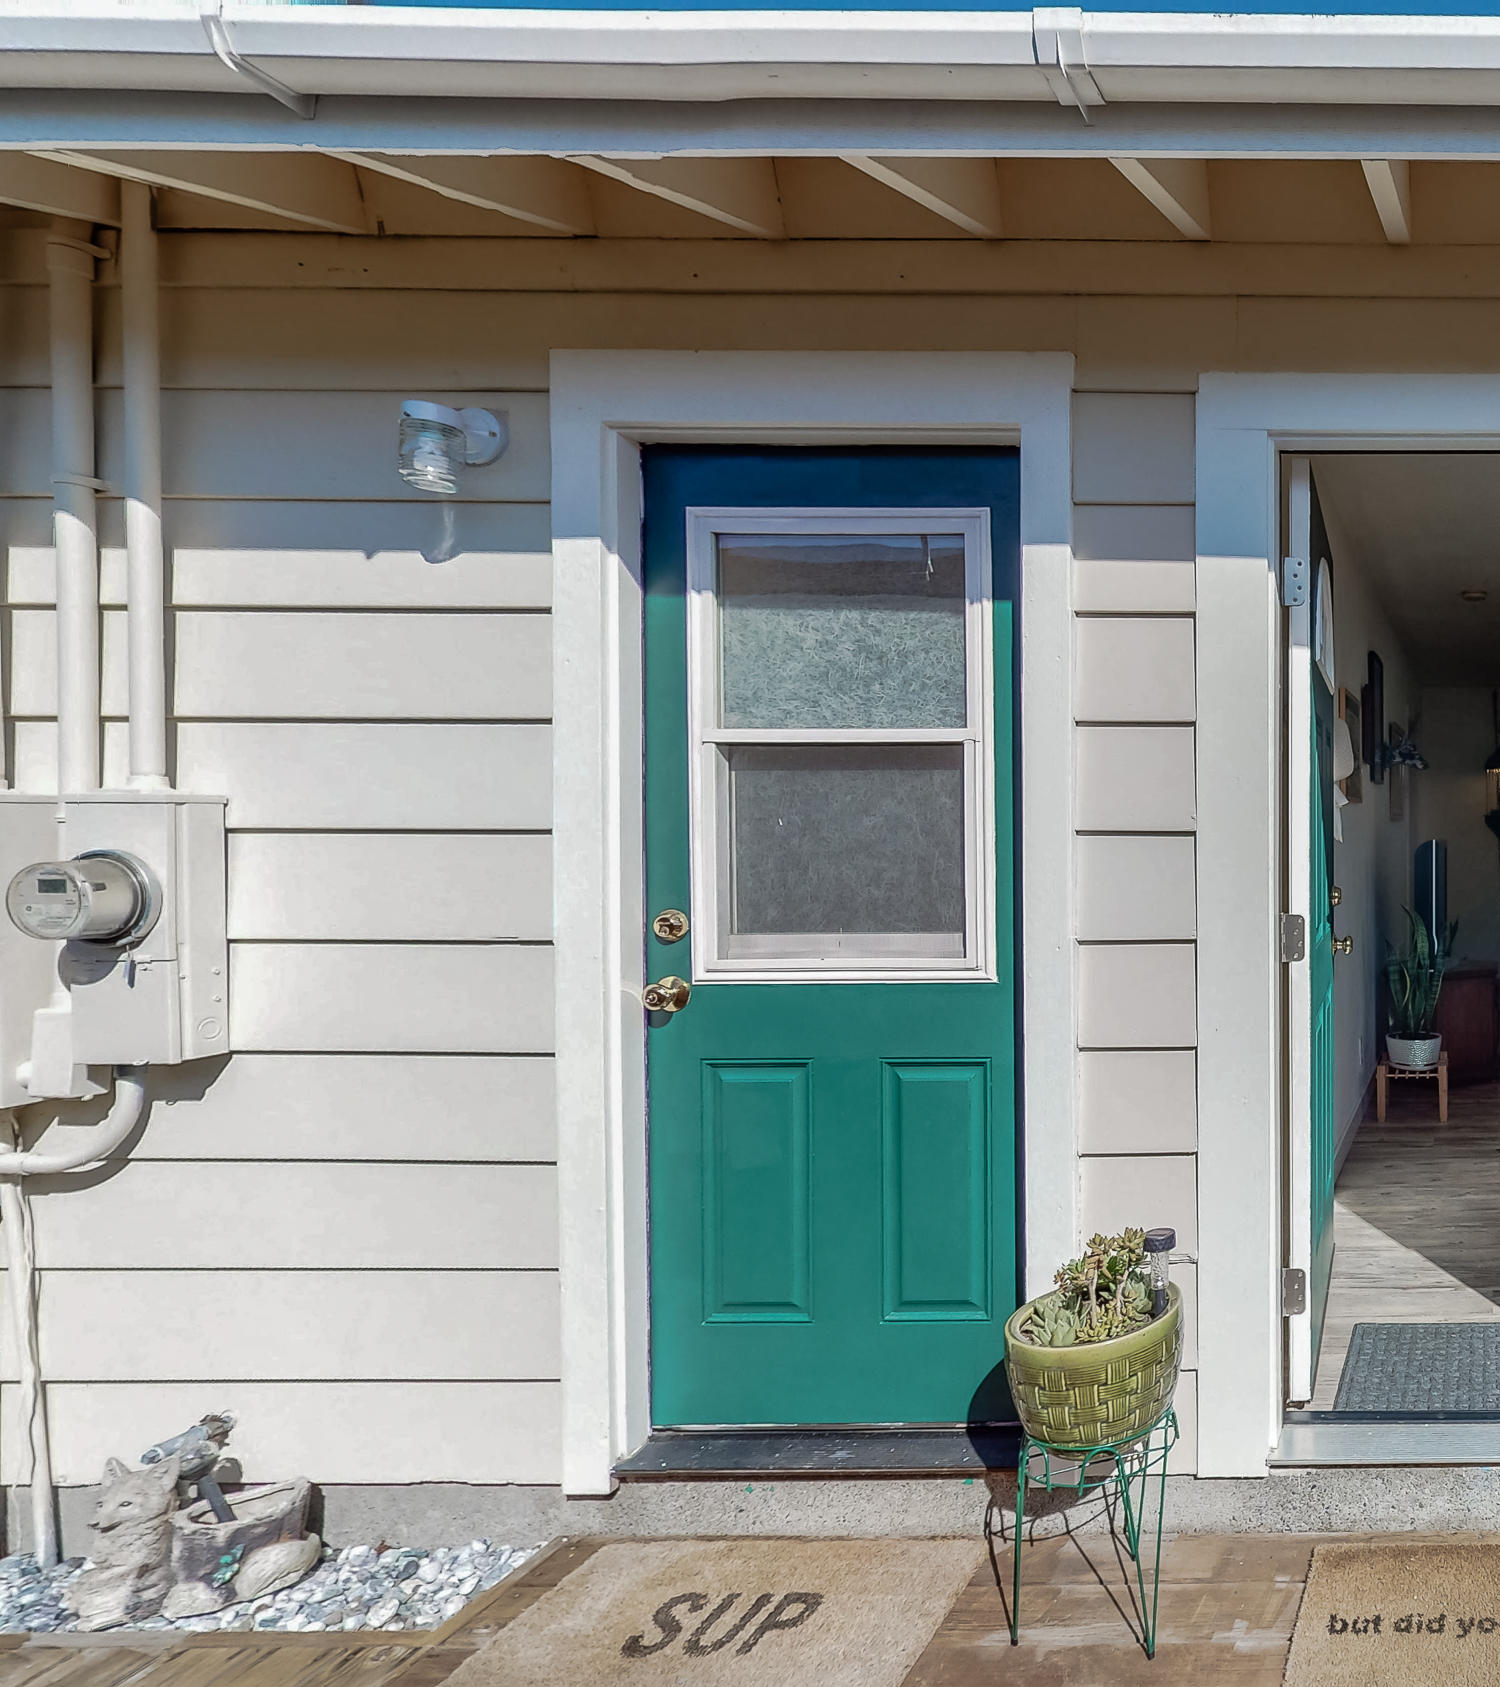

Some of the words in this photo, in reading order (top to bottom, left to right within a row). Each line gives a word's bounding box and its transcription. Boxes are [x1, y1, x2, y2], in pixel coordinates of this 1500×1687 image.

[620, 1592, 825, 1658] SUP
[1327, 1613, 1384, 1635] but
[1393, 1612, 1447, 1635] did
